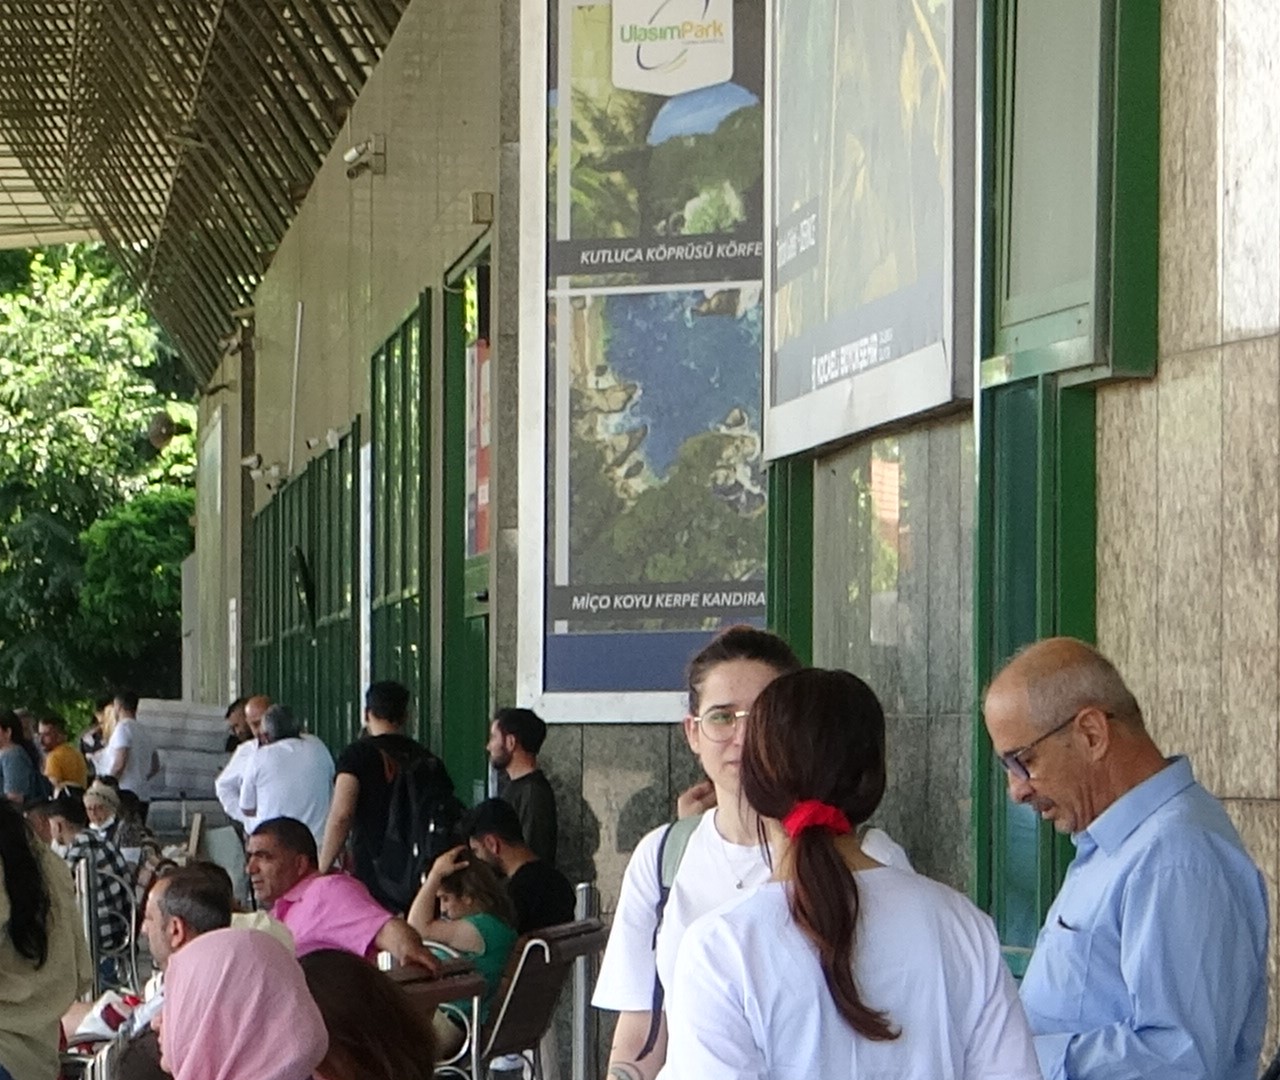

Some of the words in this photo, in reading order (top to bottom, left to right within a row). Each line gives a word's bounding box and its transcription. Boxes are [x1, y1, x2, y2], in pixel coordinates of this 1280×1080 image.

[580, 248, 644, 265] KUTLUCA
[646, 241, 713, 262] KÖPRÜSÜ
[716, 240, 763, 258] KÖRFE
[571, 593, 611, 613] MİÇO
[613, 594, 652, 609] KOYU
[655, 592, 700, 608] KERPE
[702, 591, 766, 607] KANDIRA
